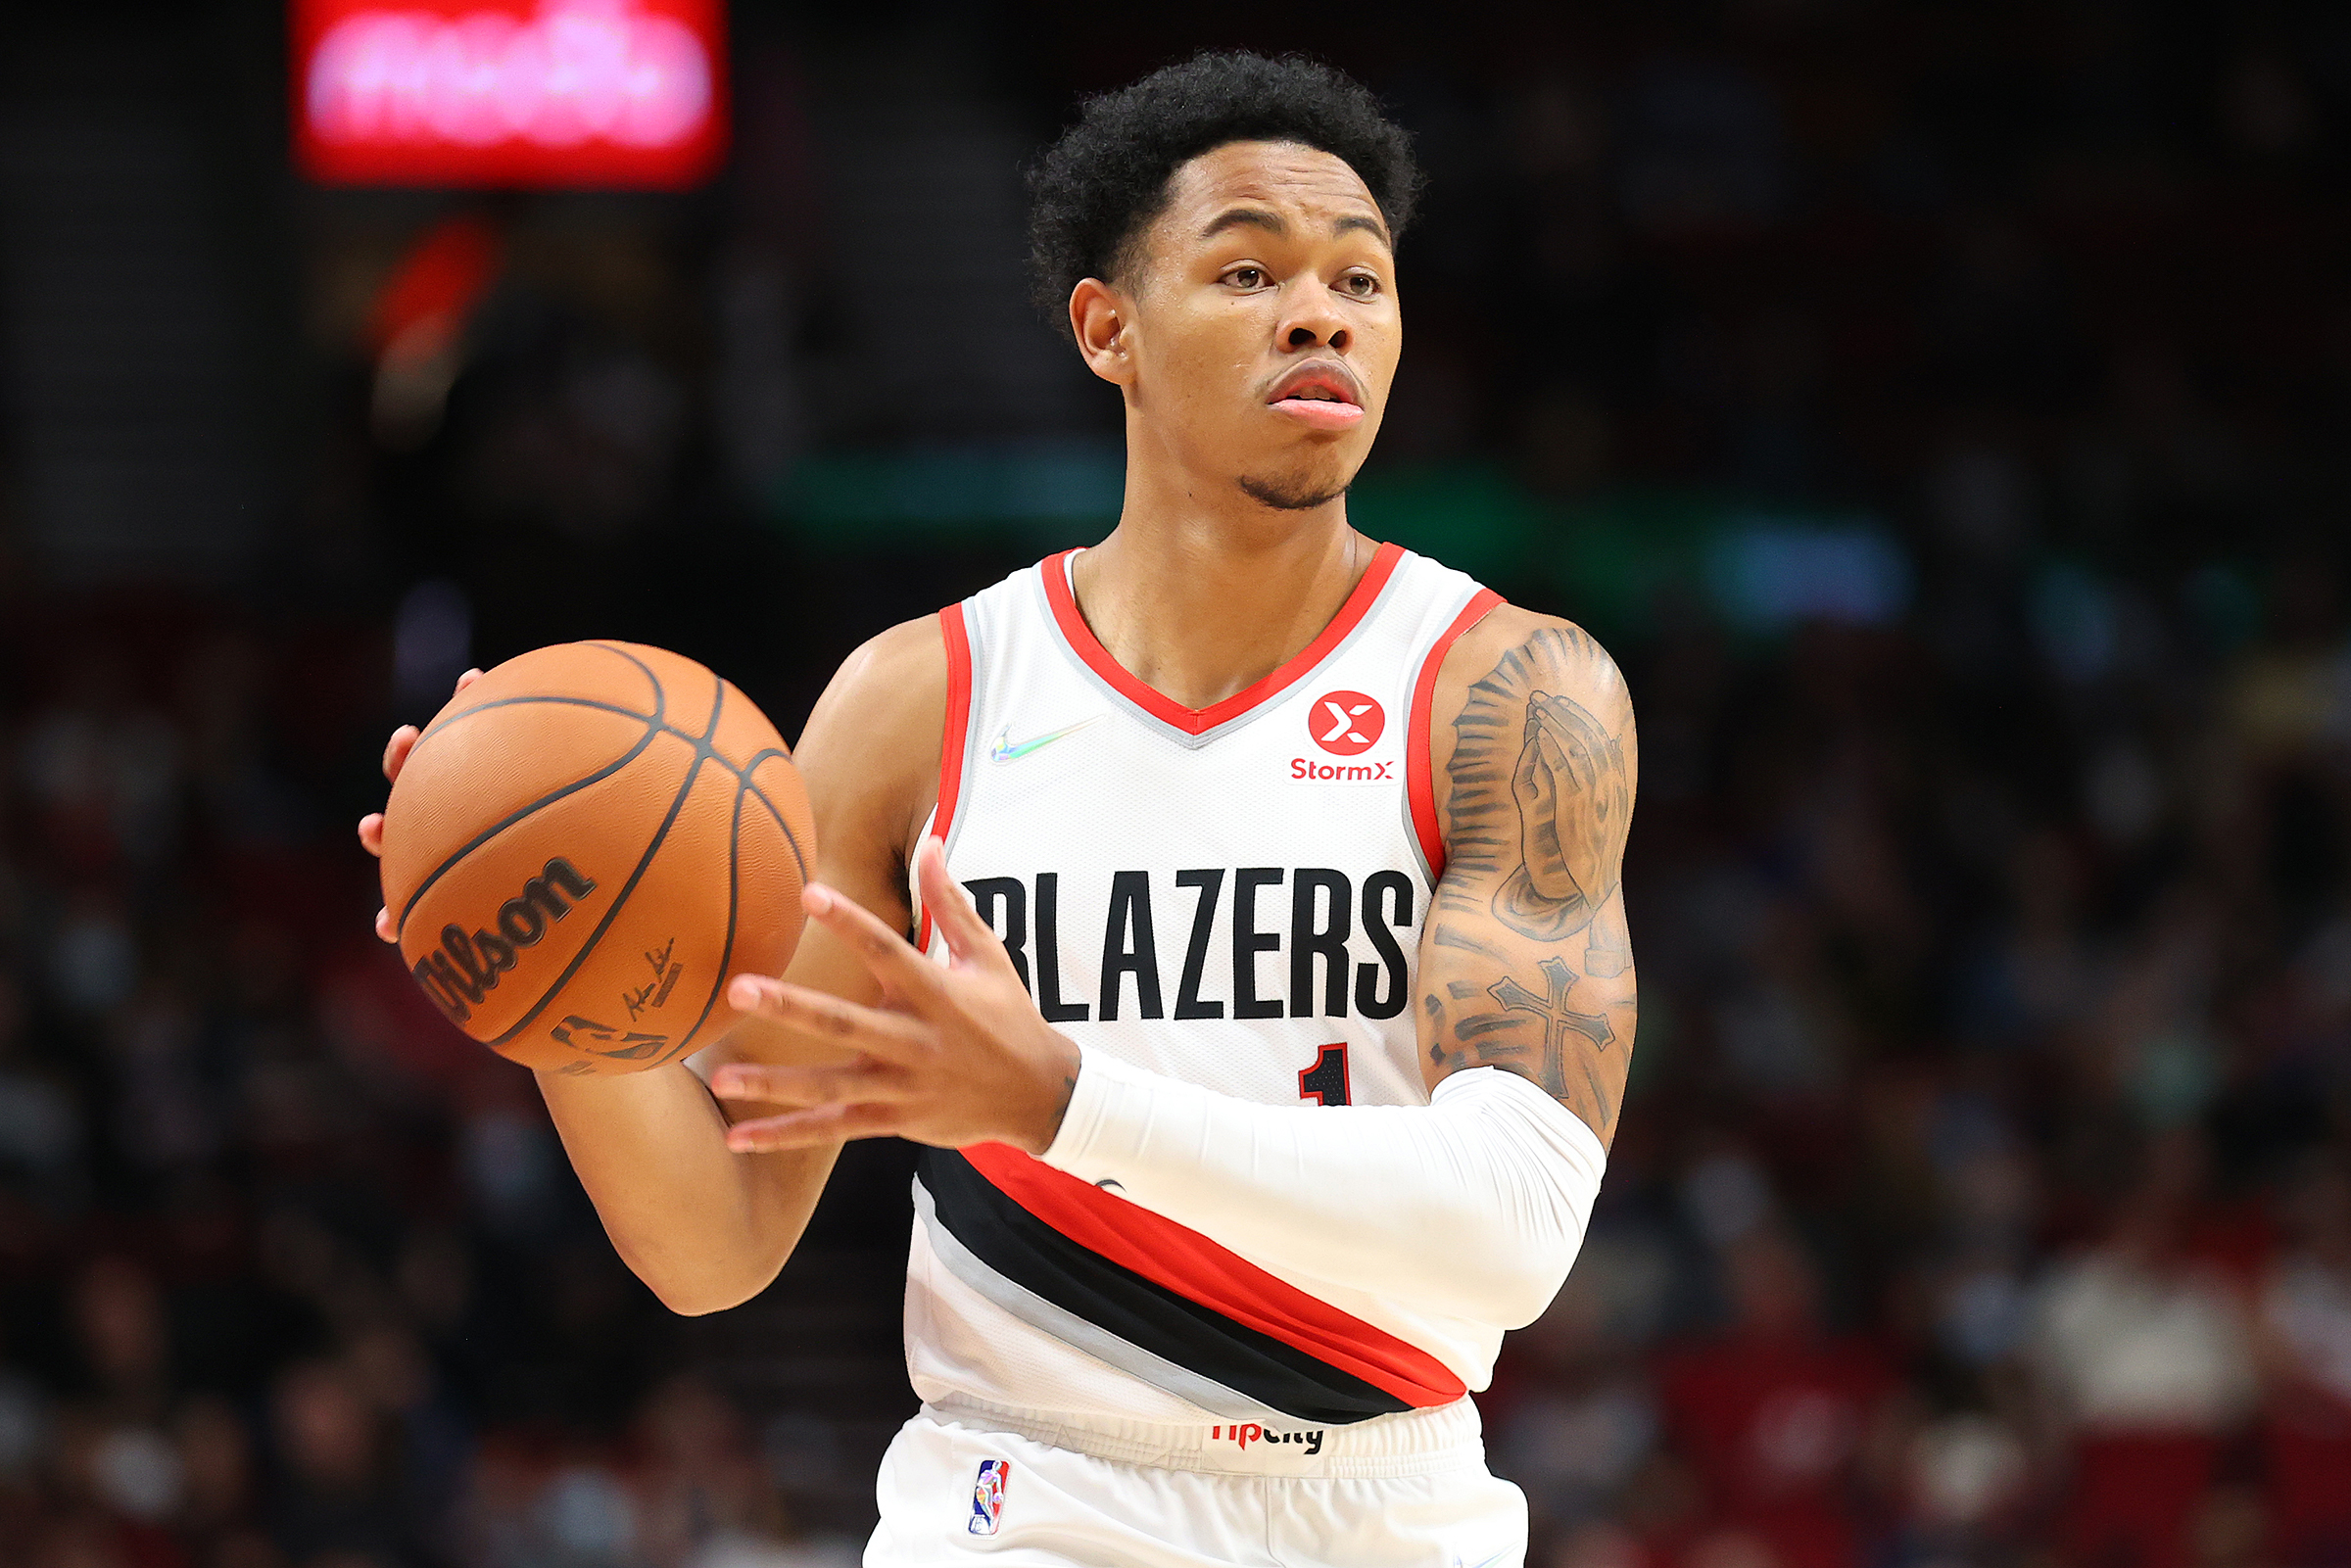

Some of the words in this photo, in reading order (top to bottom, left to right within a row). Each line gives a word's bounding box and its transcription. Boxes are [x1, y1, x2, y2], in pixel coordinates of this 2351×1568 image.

[1290, 757, 1395, 781] StormX
[960, 867, 1415, 1023] BLAZERS
[1298, 1041, 1352, 1107] 1
